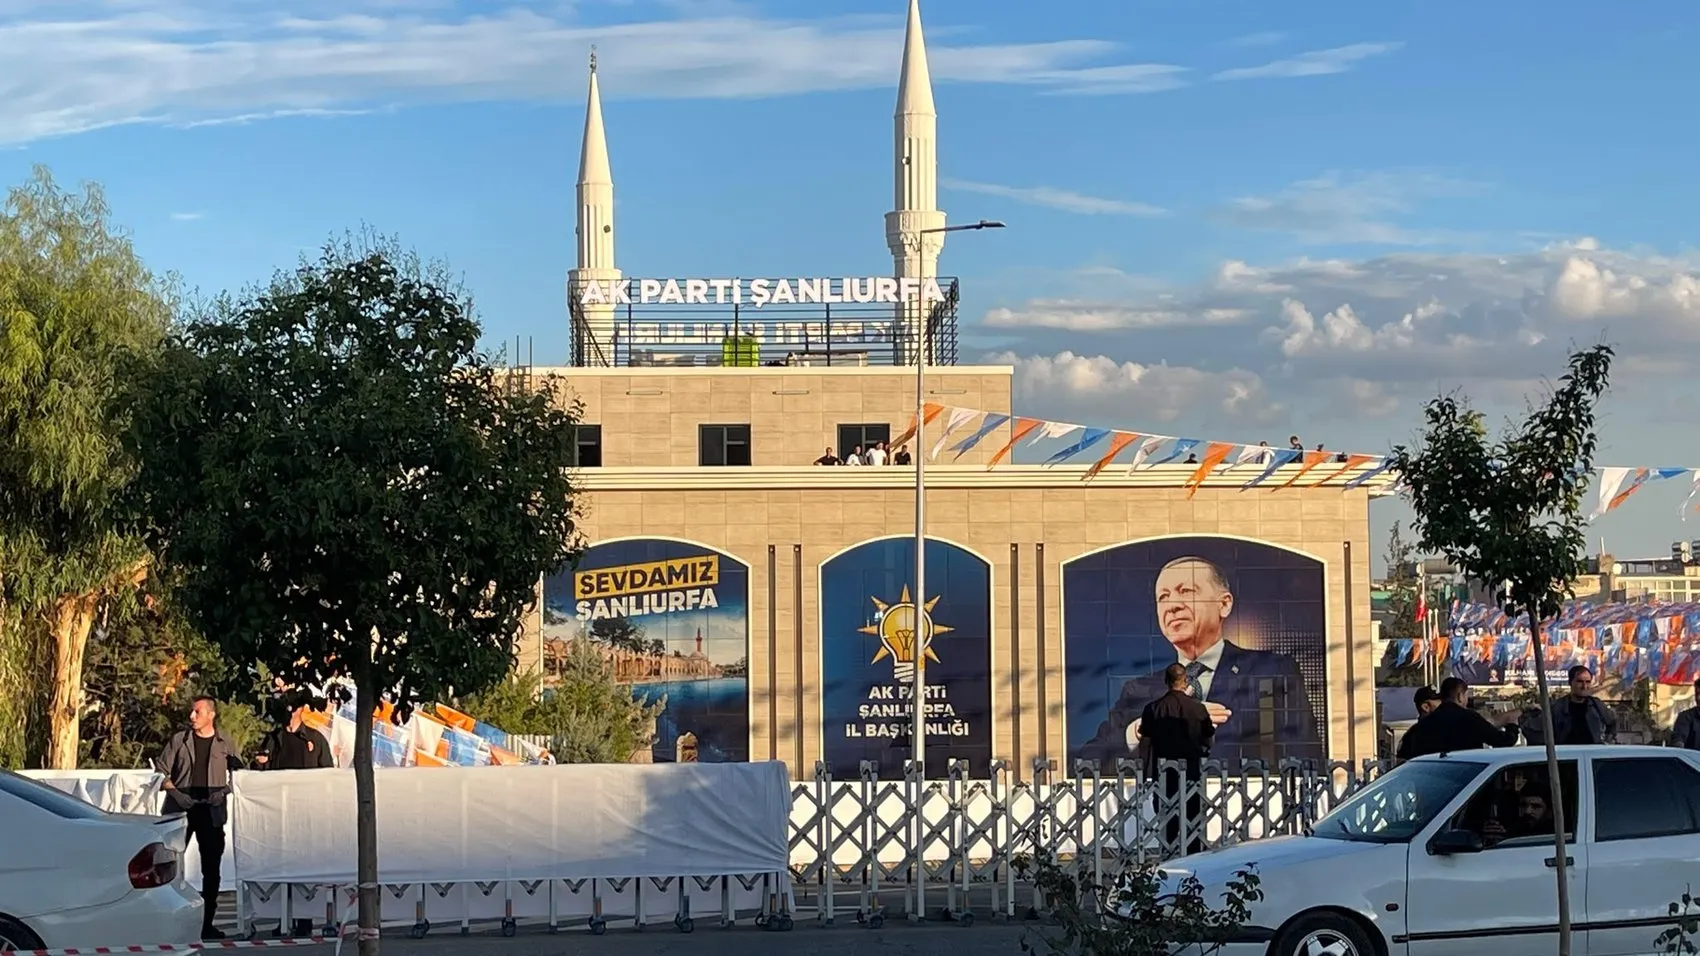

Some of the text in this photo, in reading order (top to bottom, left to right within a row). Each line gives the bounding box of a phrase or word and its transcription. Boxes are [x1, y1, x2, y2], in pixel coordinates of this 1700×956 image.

[580, 277, 946, 308] AK PARTİ ŞANLIURFA
[580, 561, 714, 595] SEVDAMIZ
[868, 686, 894, 699] AK
[859, 703, 956, 719] ŞANLIRFA
[845, 719, 969, 739] İL BAŞKNLIĞI
